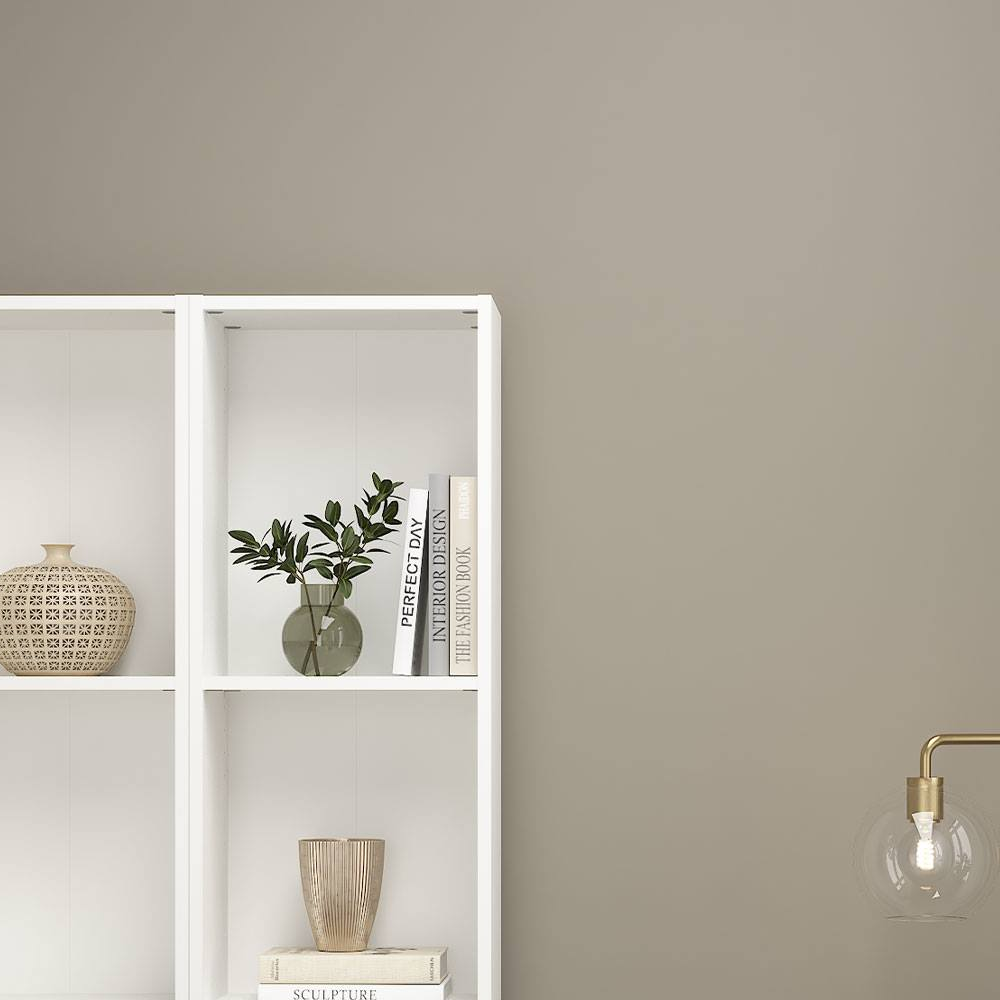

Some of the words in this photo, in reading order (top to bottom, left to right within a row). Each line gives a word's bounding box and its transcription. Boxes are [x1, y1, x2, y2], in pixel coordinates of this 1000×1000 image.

[408, 518, 424, 550] DAY
[432, 508, 447, 567] DESIGN
[455, 546, 472, 580] BOOK
[401, 553, 420, 628] PERFECT
[432, 570, 447, 643] INTERIOR
[455, 582, 472, 635] FASHION
[455, 636, 472, 664] THE
[293, 988, 378, 1000] SCULPTURE
